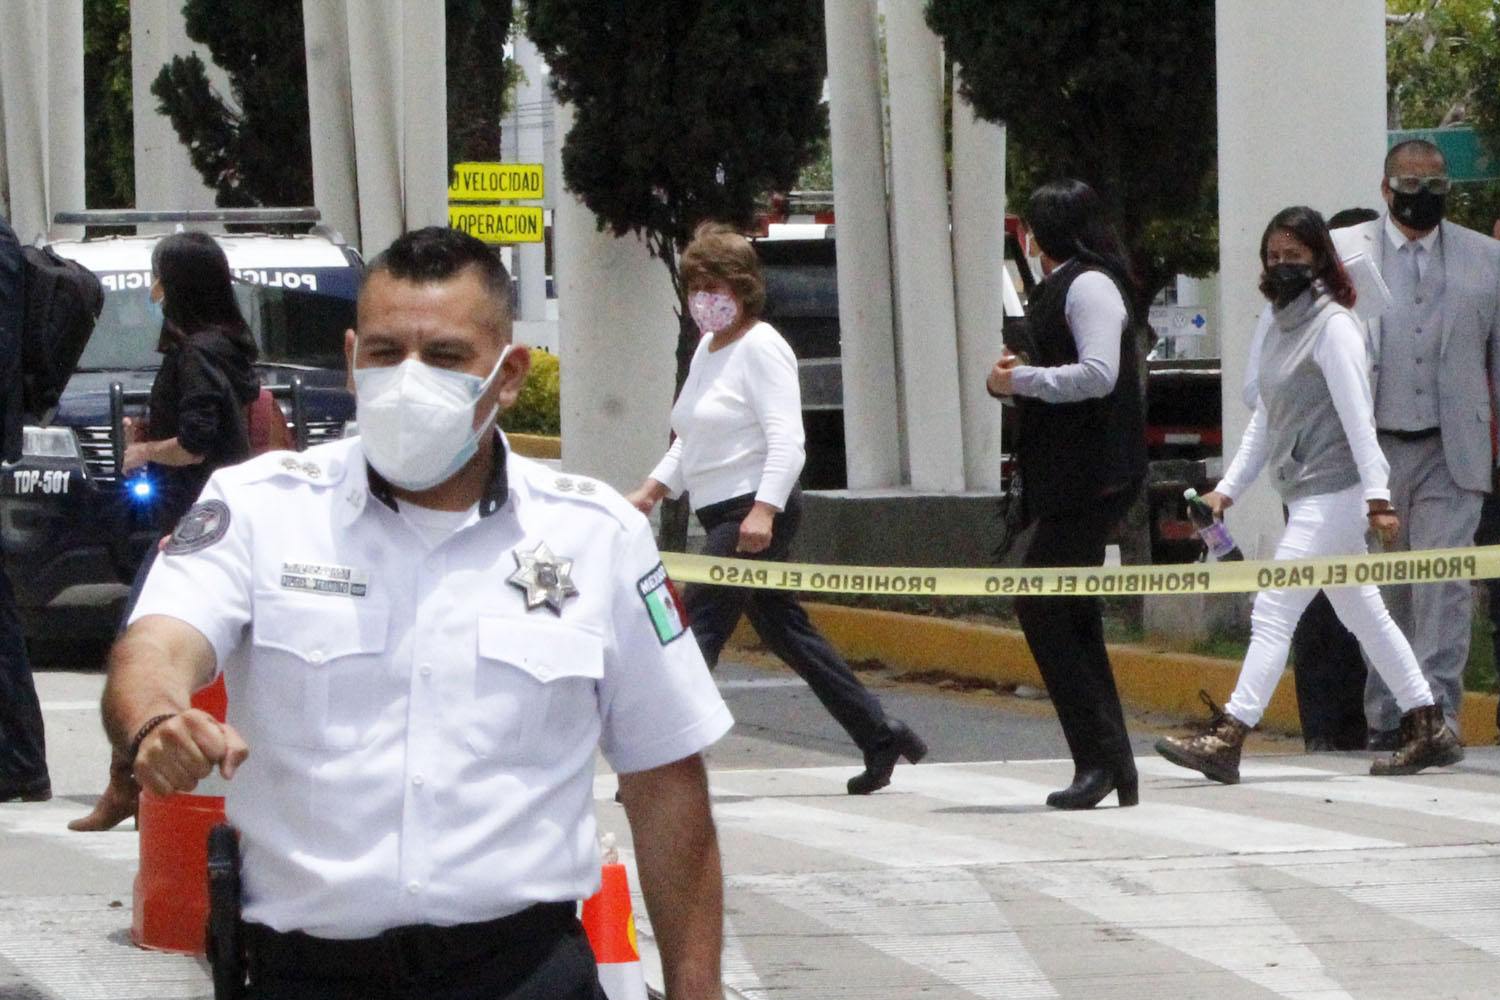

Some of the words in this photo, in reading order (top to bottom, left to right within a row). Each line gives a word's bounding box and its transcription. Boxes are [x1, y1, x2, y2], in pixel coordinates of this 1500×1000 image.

[463, 171, 540, 191] VELOCIDAD
[458, 214, 537, 235] OPERACION
[13, 470, 71, 494] TDP-501
